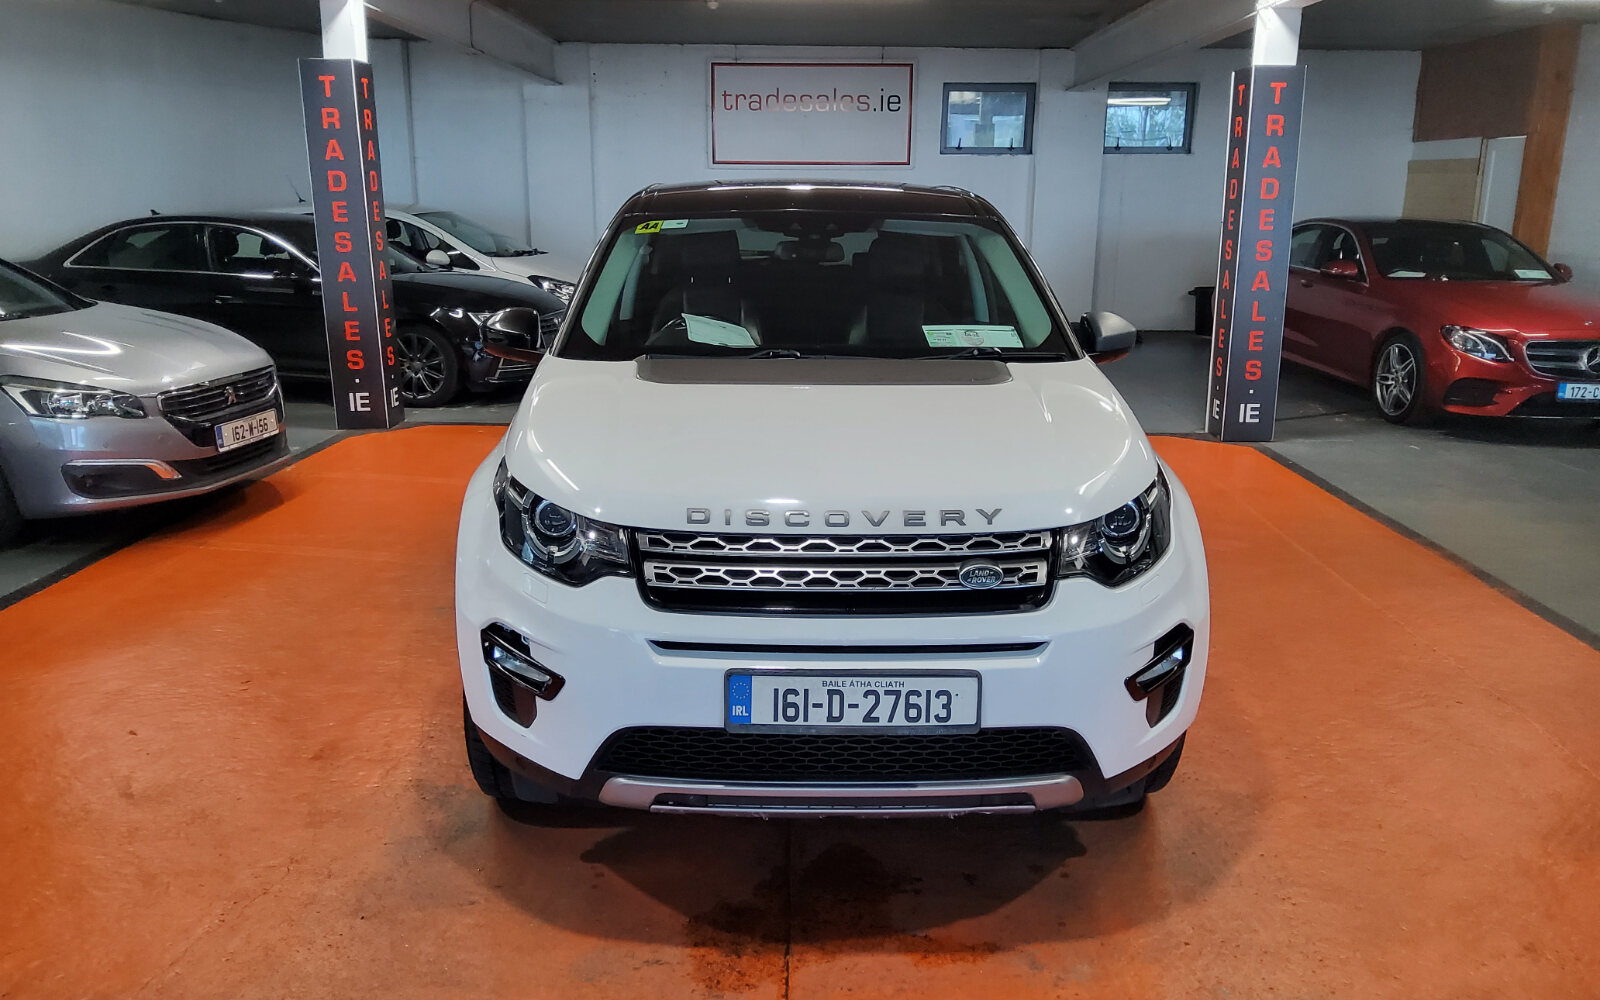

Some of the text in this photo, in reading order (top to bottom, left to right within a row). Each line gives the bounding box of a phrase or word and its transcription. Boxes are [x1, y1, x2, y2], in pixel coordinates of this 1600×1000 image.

[722, 88, 902, 112] tradesales.ie
[640, 222, 660, 230] AA
[231, 417, 269, 442] 162-W-156
[686, 507, 1003, 528] DISCOVERY
[821, 679, 905, 688] BAILE ÁTHA CLIATH
[732, 705, 749, 717] IRL
[773, 688, 953, 723] 161-D-27613
